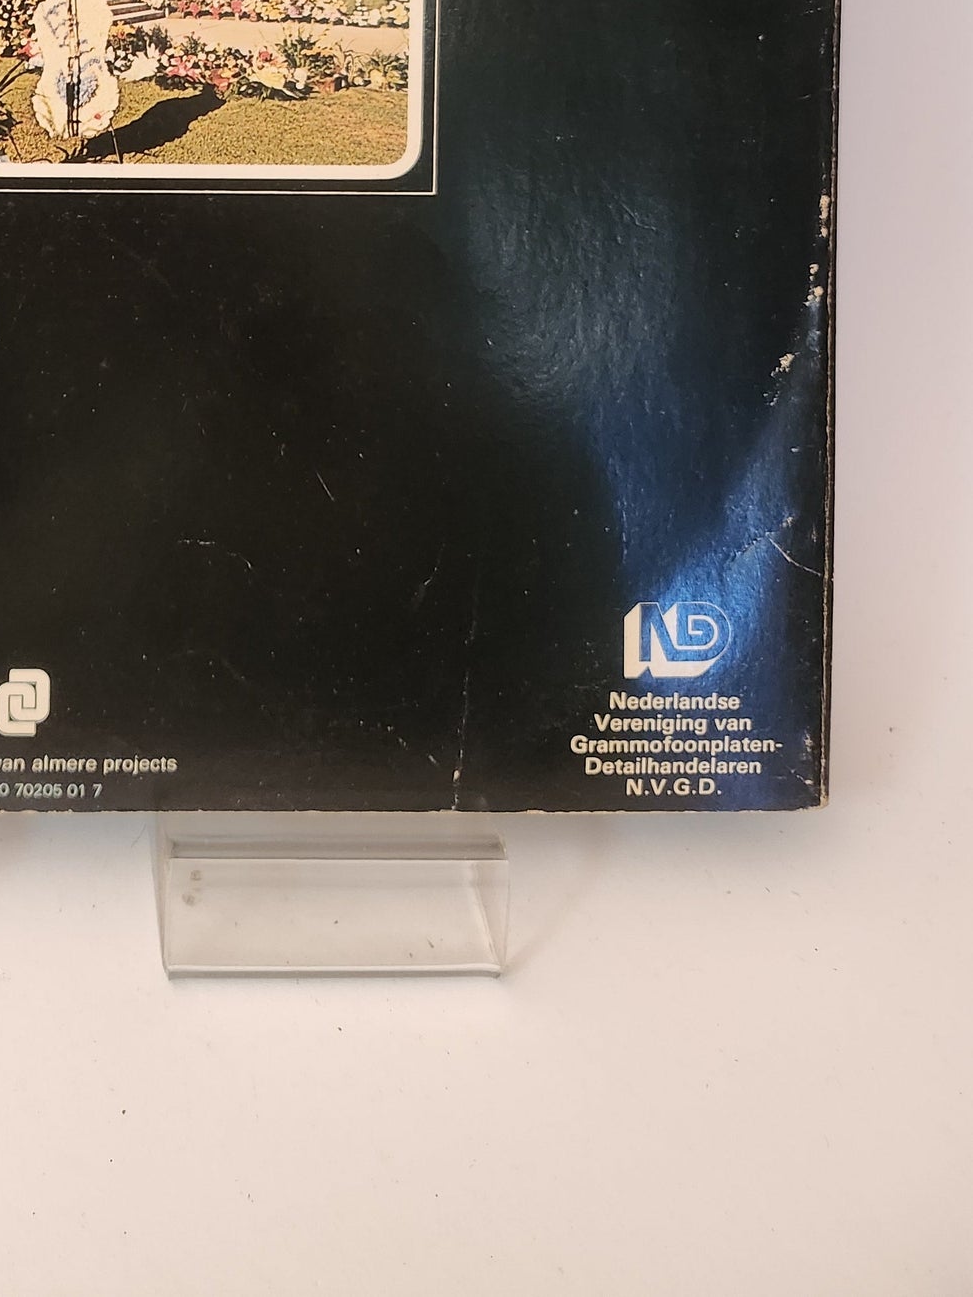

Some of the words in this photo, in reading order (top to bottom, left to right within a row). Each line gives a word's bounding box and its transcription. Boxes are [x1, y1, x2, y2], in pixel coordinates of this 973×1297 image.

[609, 691, 741, 711] Nederlandse
[594, 713, 708, 735] Vereniging
[714, 716, 753, 732] van
[570, 735, 784, 756] Grammofoonplaten-
[31, 754, 98, 773] almere
[103, 754, 178, 776] projects
[585, 757, 762, 776] Detailhandelaren
[14, 782, 63, 798] 70205
[67, 783, 85, 798] 01
[92, 783, 103, 798] 7
[626, 778, 723, 797] N.V.G.D.
